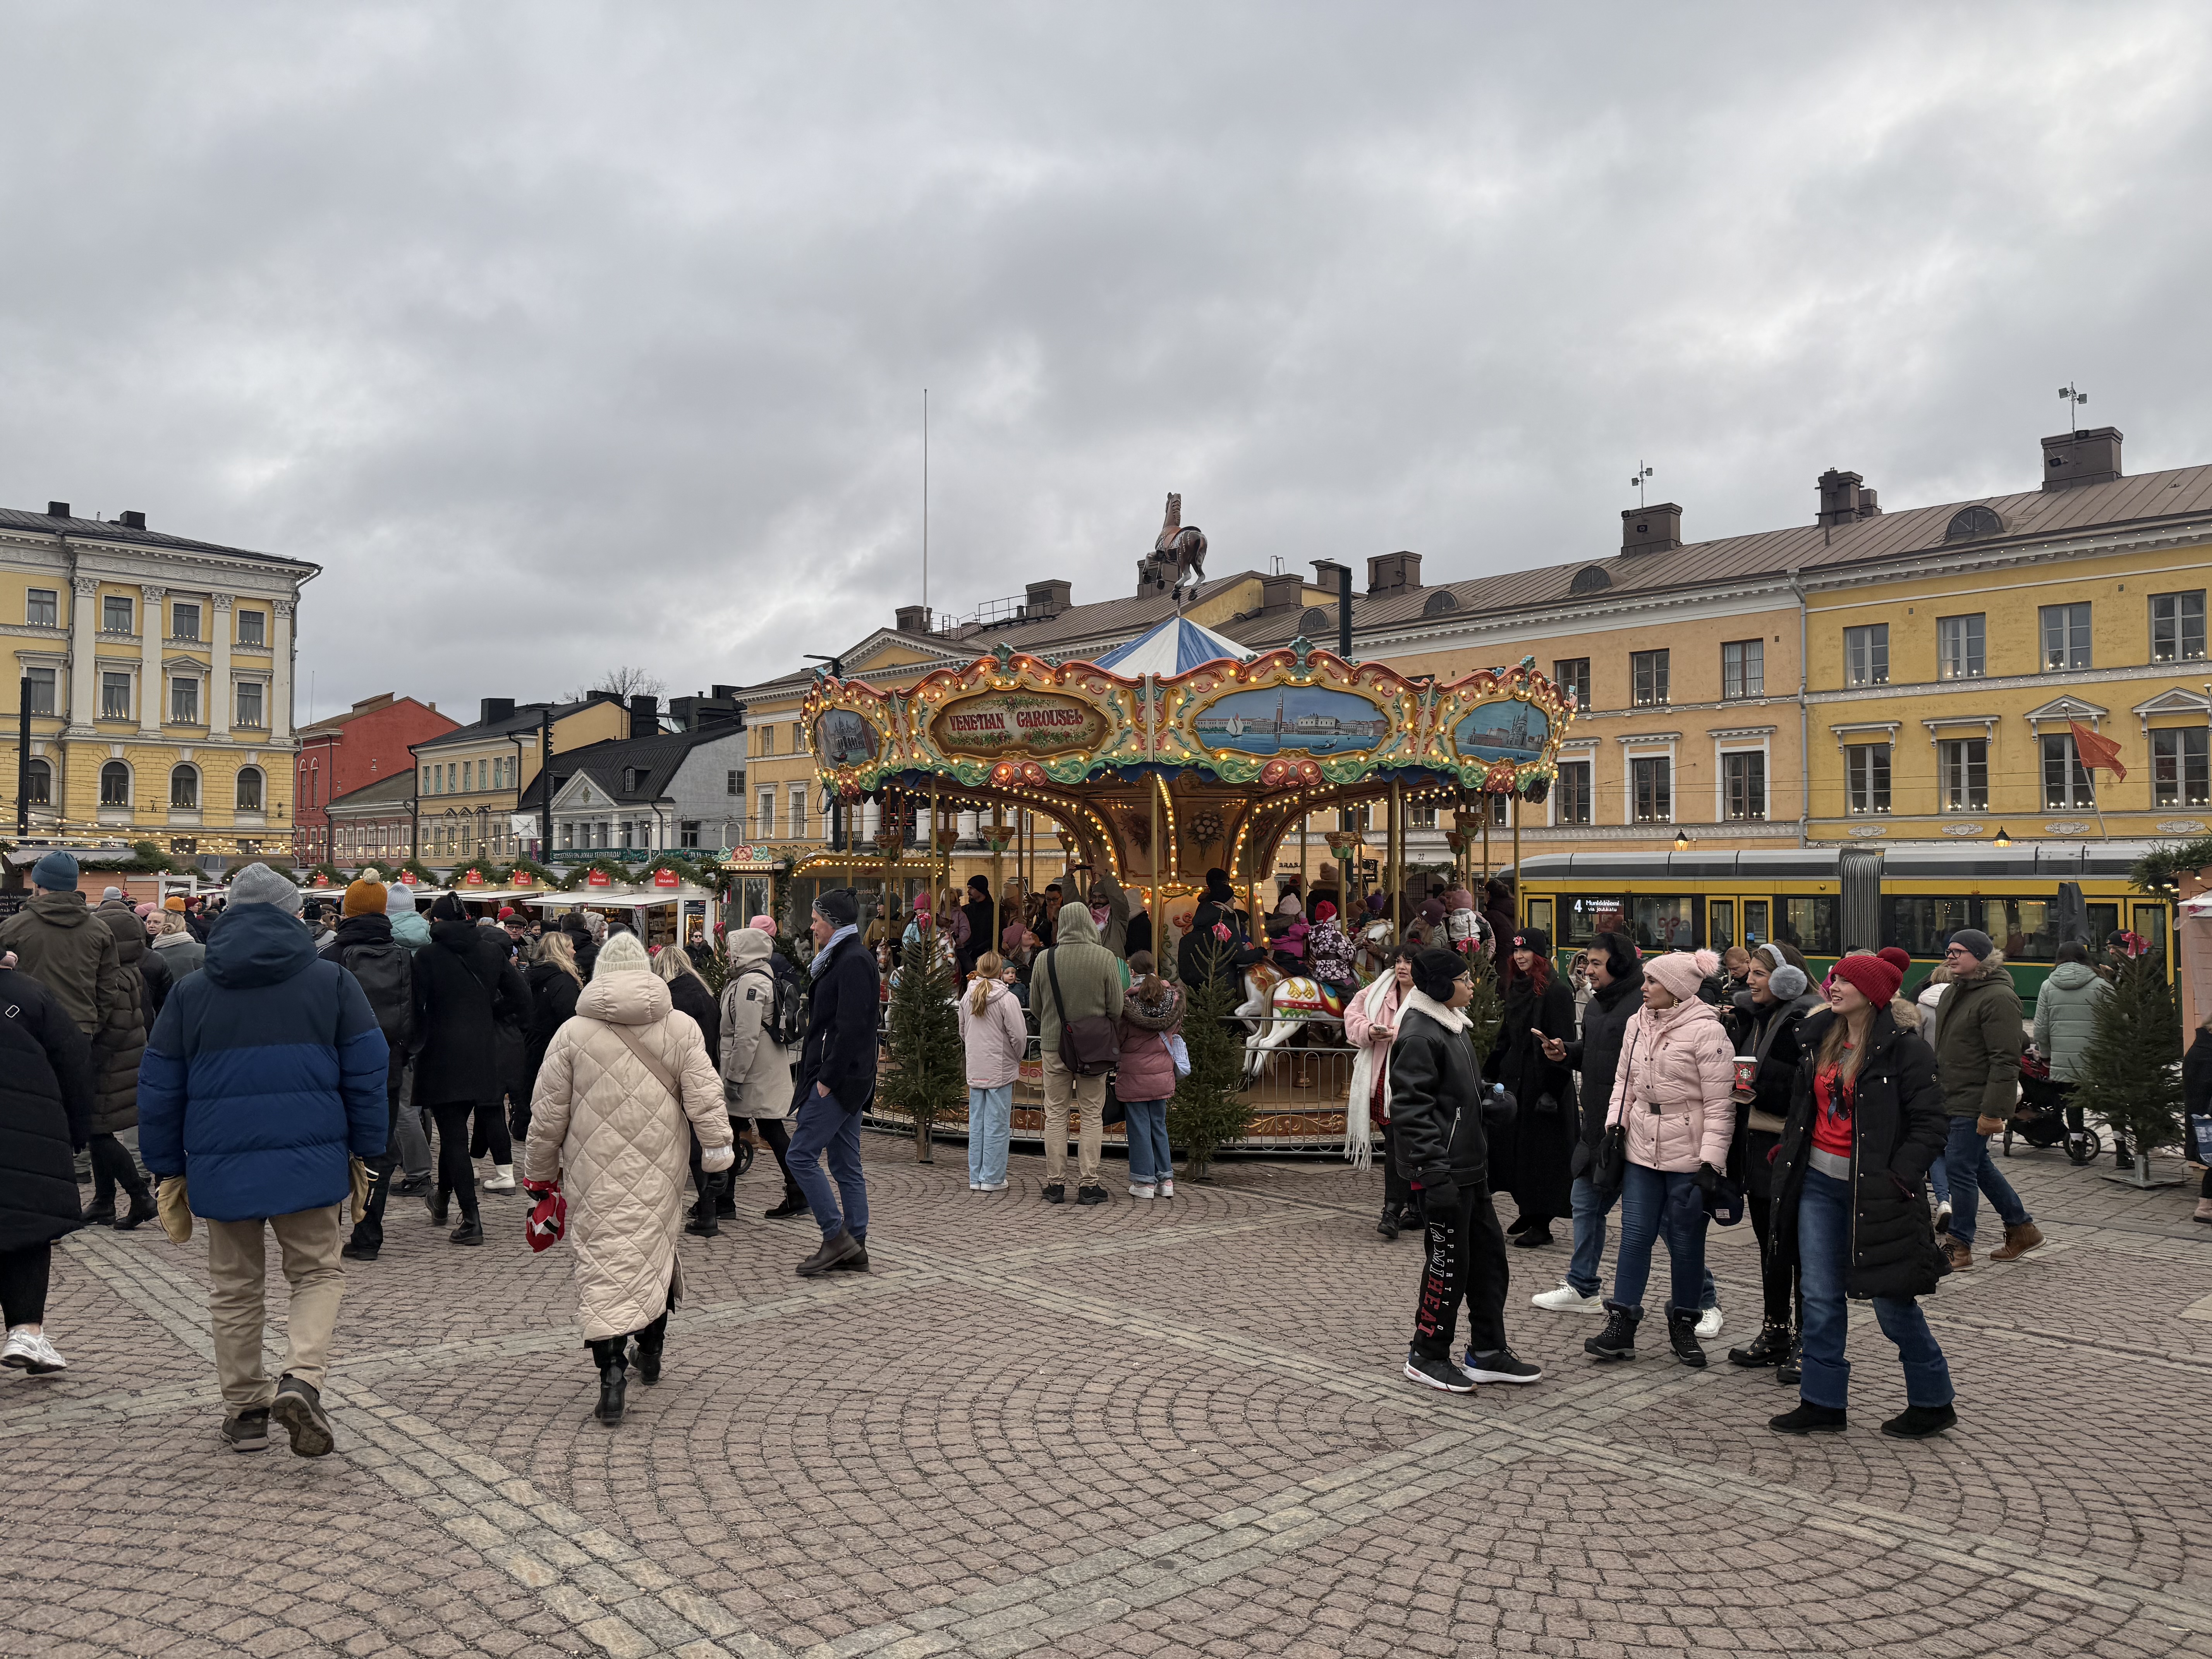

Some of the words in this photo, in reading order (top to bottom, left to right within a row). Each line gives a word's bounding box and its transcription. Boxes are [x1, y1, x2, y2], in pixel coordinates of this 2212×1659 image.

[948, 713, 1005, 731] VENETIAN
[1016, 709, 1084, 728] CAROUSEL
[1574, 899, 1582, 913] 4
[1429, 1221, 1445, 1278] IAMI
[1442, 1229, 1455, 1306] OPERTY
[1417, 1274, 1444, 1338] HEAT
